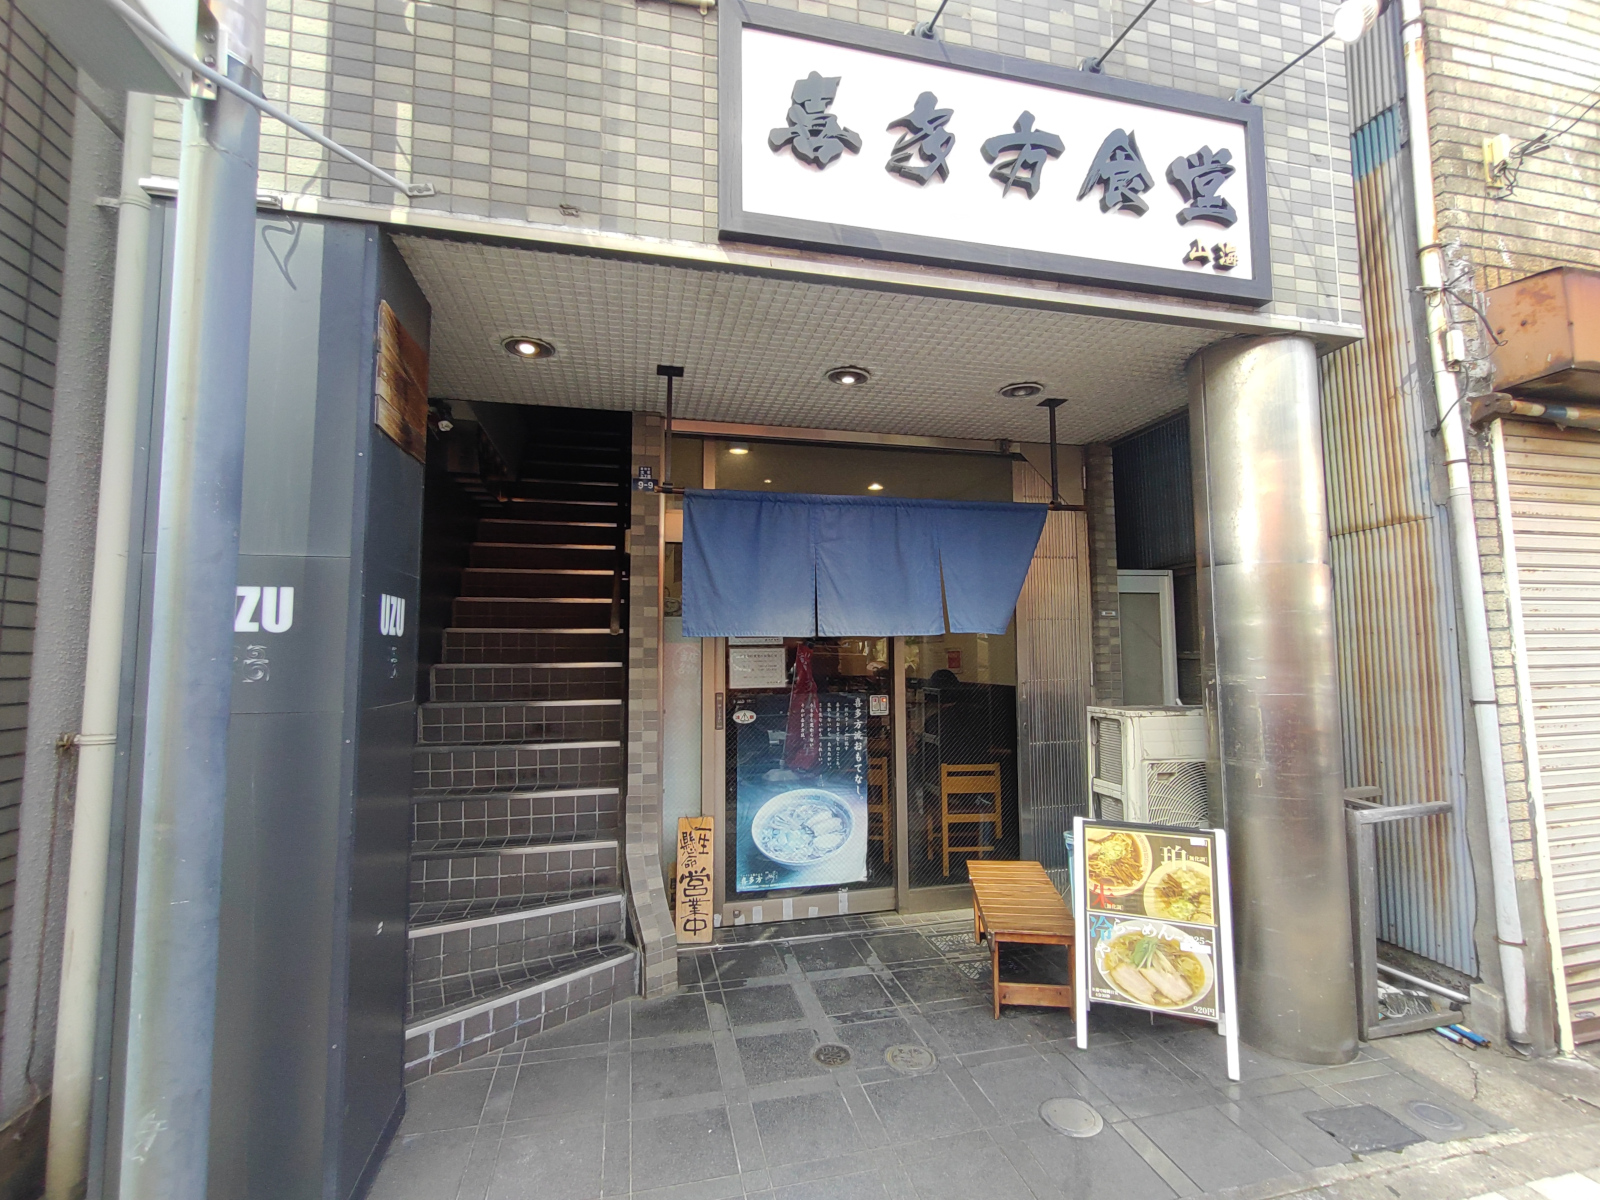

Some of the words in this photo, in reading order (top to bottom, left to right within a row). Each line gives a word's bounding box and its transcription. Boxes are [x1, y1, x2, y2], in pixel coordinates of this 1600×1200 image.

[768, 70, 1237, 228] 喜多方食堂
[637, 480, 654, 490] 9-9
[379, 593, 406, 637] UZU
[853, 697, 864, 800] 喜多方流おもてなし。
[679, 831, 698, 869] 懸命
[694, 826, 712, 855] 一生
[678, 867, 711, 936] 営業中
[1193, 1005, 1215, 1016] 920円
